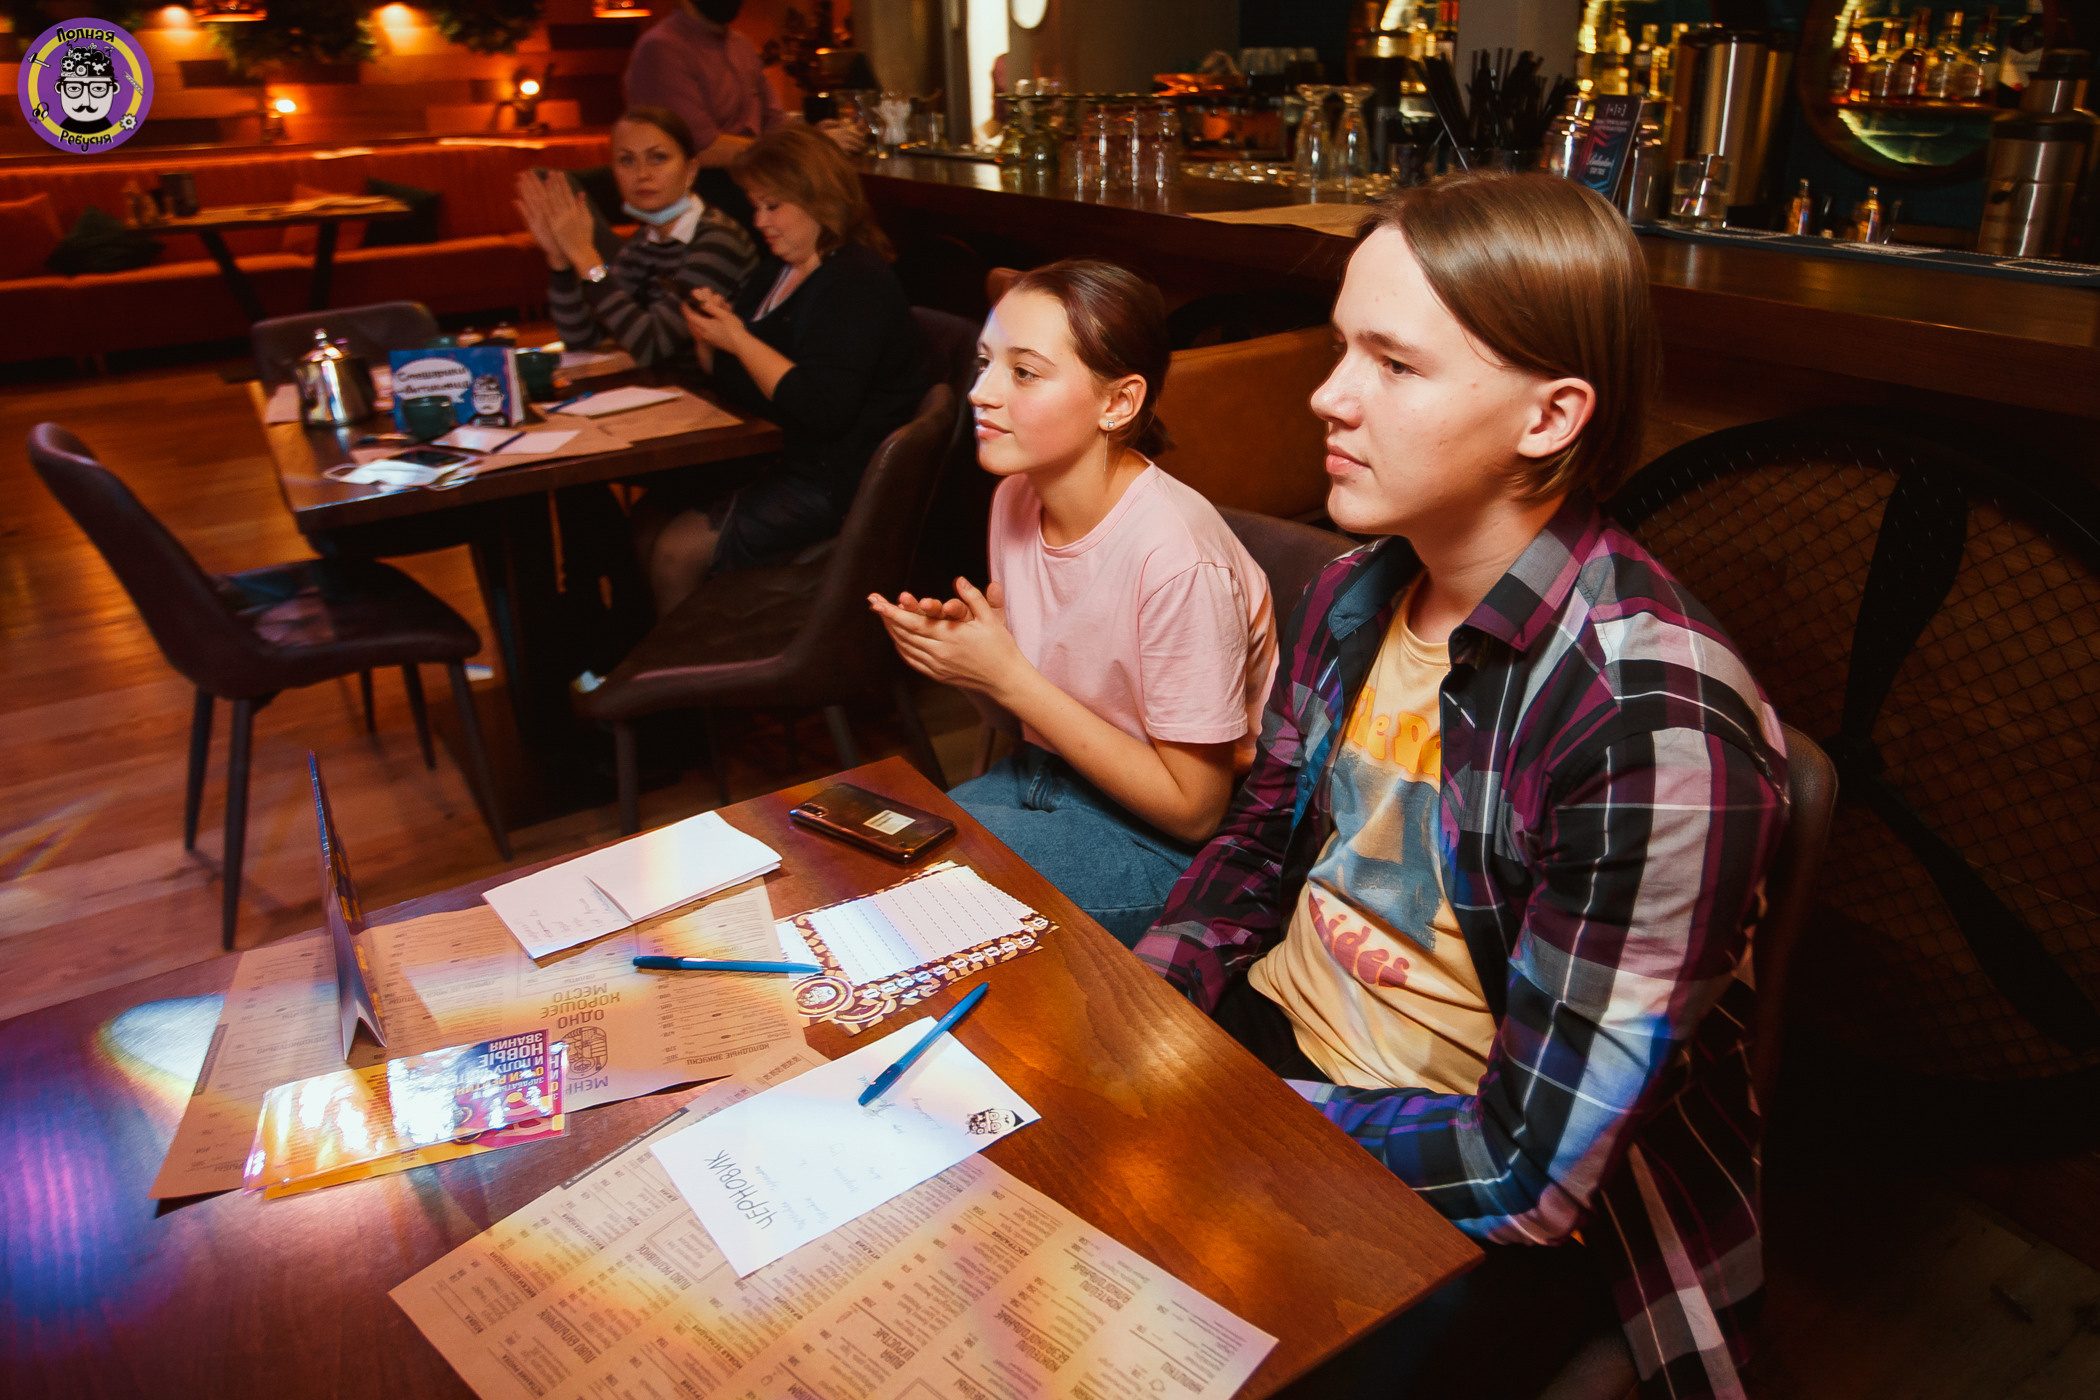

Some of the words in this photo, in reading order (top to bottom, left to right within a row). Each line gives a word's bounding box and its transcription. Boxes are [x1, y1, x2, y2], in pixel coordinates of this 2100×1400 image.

[538, 991, 621, 1018] ХОРОШЕЕ
[551, 982, 608, 1003] МЕСТО
[557, 1008, 605, 1028] ОДНО
[490, 1033, 543, 1051] ЗВАНИЯ
[725, 1042, 769, 1058] ХОЛОДНЫЕ
[478, 1043, 544, 1066] НОВЫЕ
[686, 1053, 723, 1065] ЗАКУСКИ
[705, 1149, 775, 1230] ЧЕРНОВИК
[934, 1172, 963, 1194] ИСПАНИ
[625, 1214, 641, 1227] РОМ
[854, 1238, 880, 1261] ИТАЛИЯ
[990, 1228, 1029, 1258] АВСТРАЛИЯ
[635, 1241, 675, 1277] РАЗЛИВНОЕ
[668, 1269, 692, 1291] ПИВО
[1069, 1259, 1131, 1305] АЛКОГОЛЬНЫЕ
[1078, 1277, 1124, 1313] КОКТЕЙЛИ
[536, 1305, 581, 1349] БУТЫЛОЧНОЕ
[993, 1307, 1070, 1365] БЕЗАЛКОГОЛЬНЫЕ
[572, 1340, 597, 1365] ПИВО
[871, 1326, 915, 1362] ИГРИСТЫЕ
[1013, 1337, 1061, 1375] КОКТЕЙЛИ
[878, 1347, 905, 1370] ВИНА
